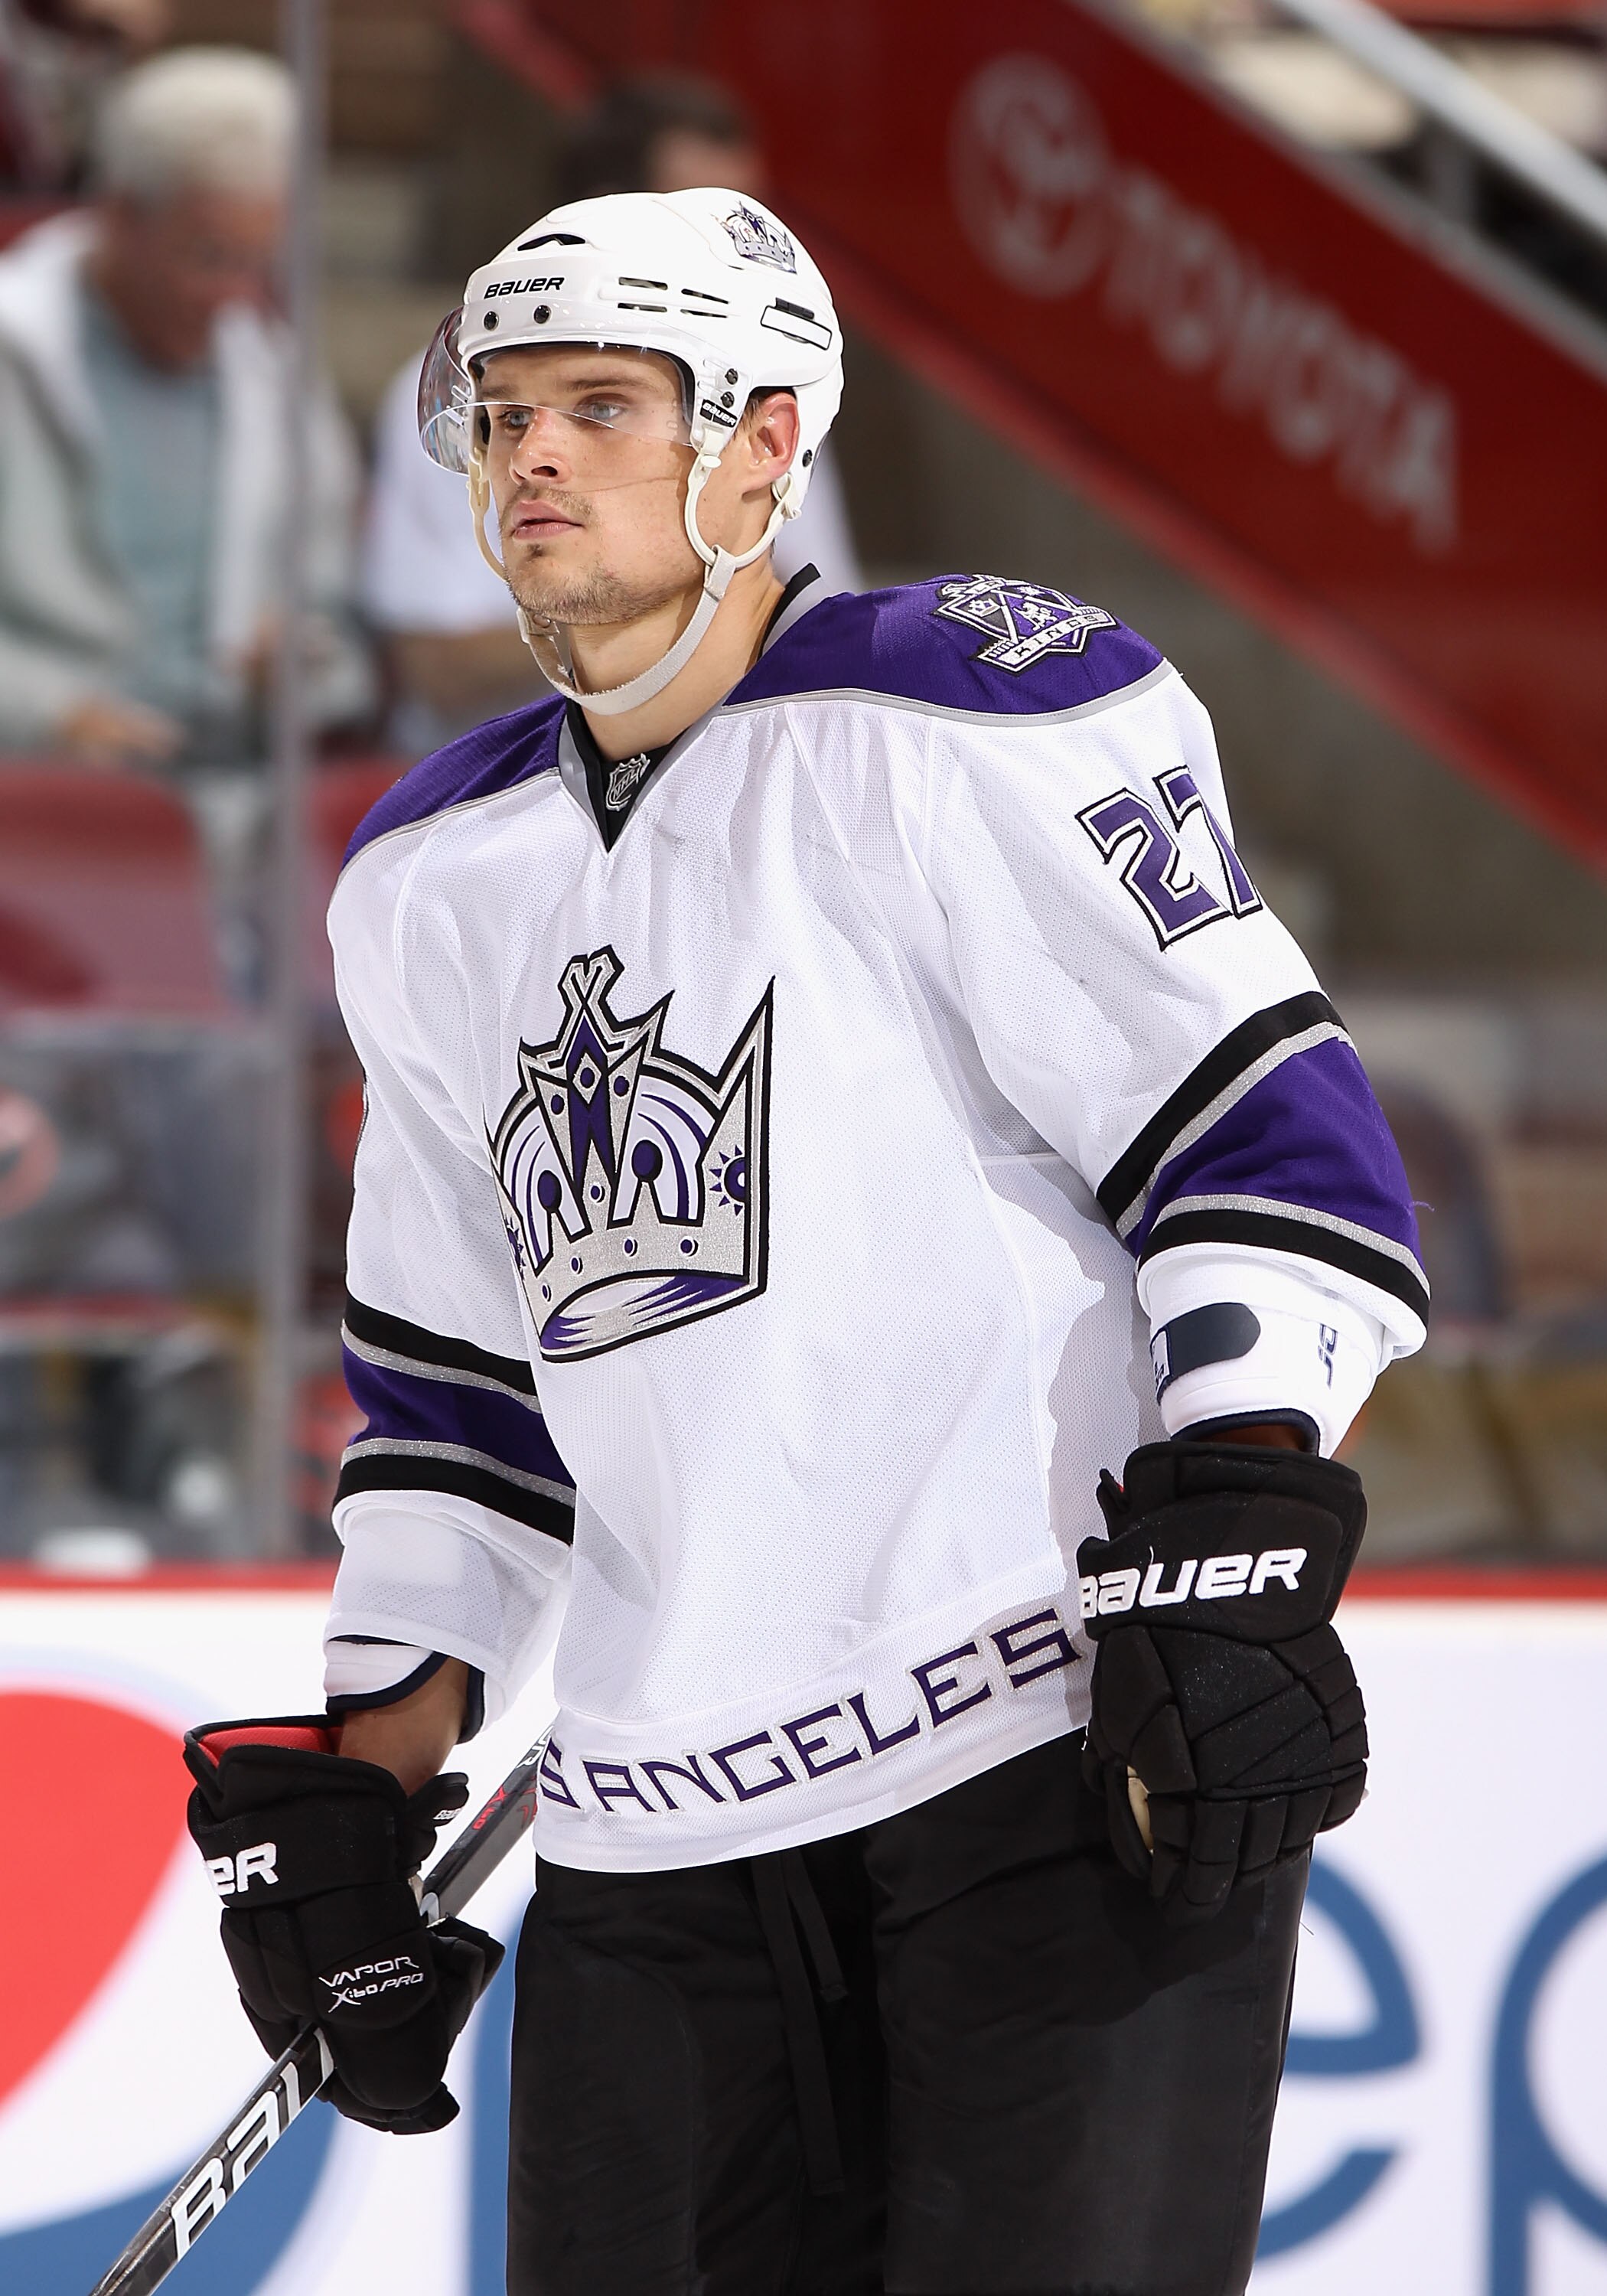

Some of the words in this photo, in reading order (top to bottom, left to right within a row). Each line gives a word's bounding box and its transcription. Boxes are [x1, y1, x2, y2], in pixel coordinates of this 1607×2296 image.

[484, 277, 565, 299] BAUER
[702, 402, 736, 426] BAUER
[1074, 765, 1263, 952] 27
[580, 1606, 1083, 1814] ANGELES
[318, 1956, 420, 1988] VAPOR
